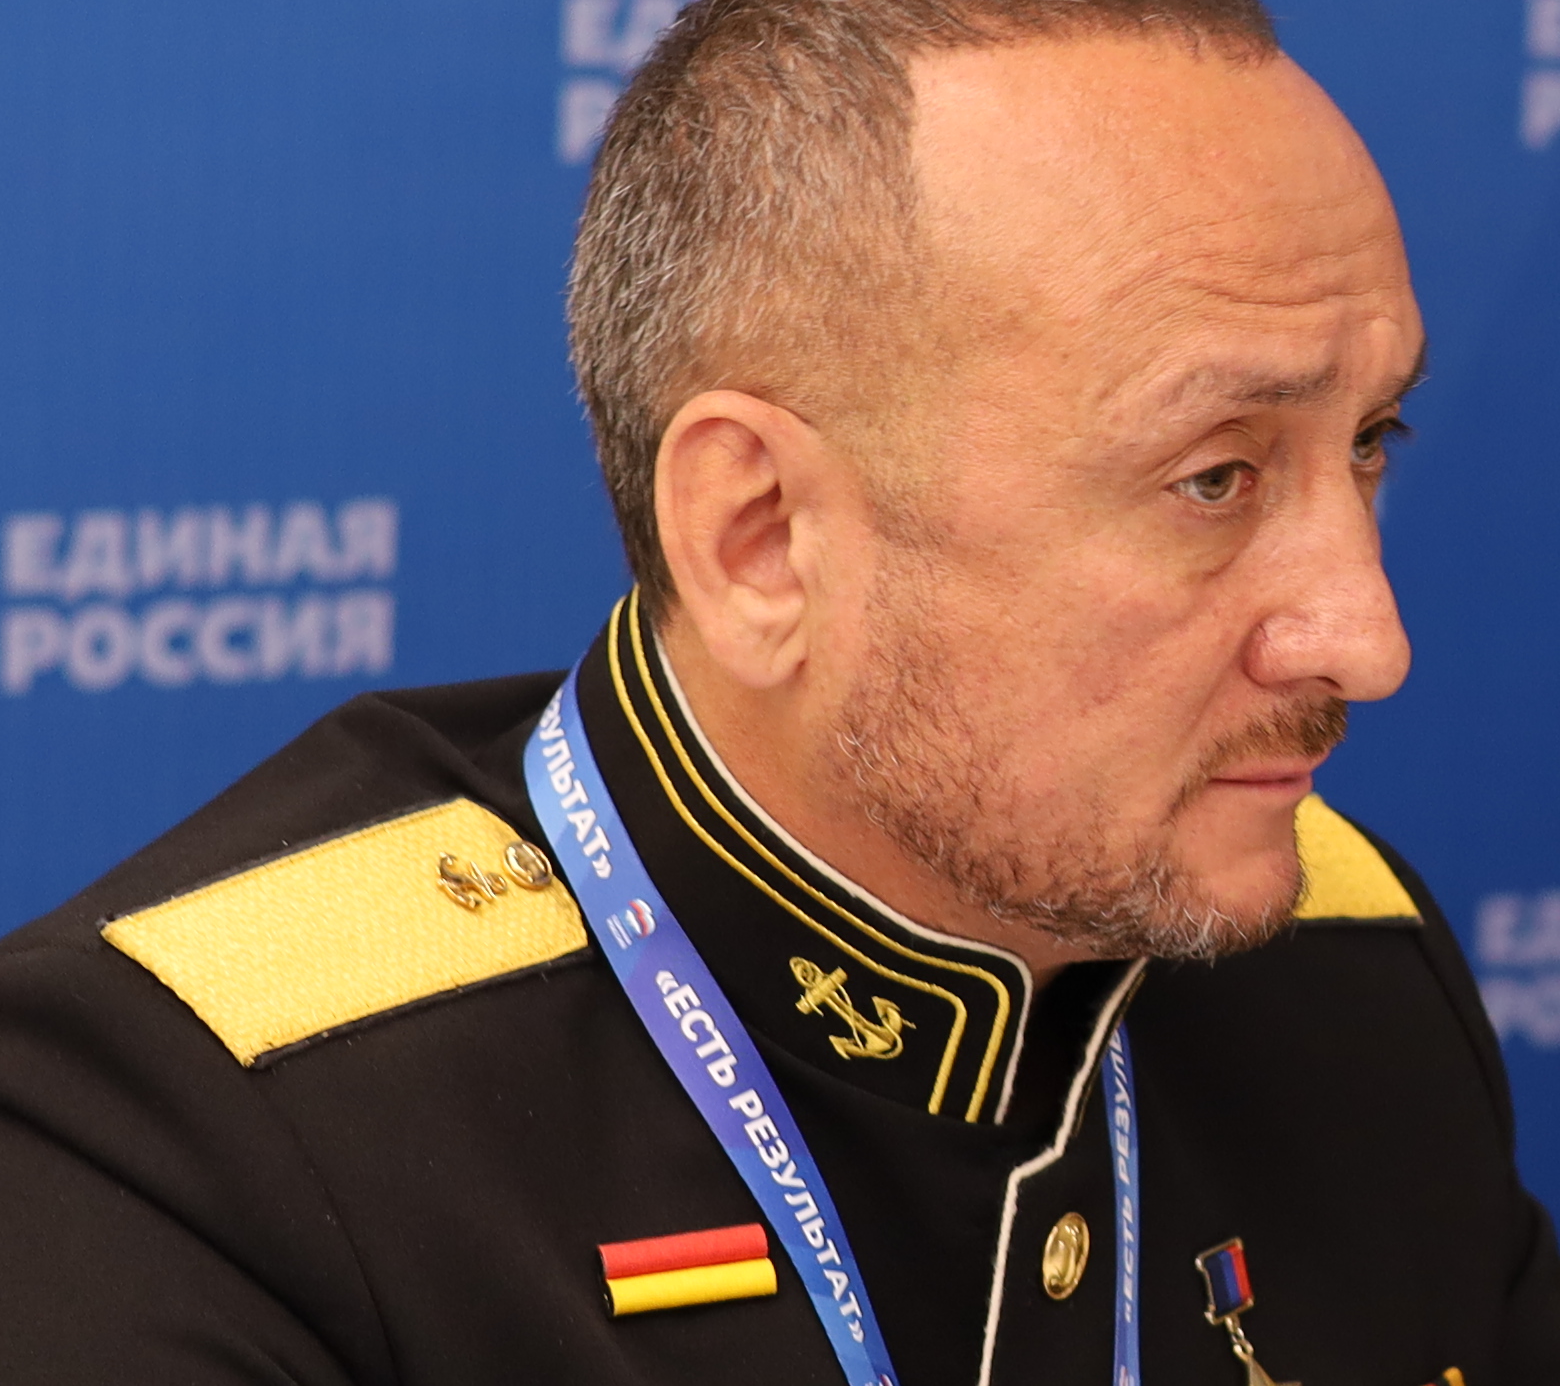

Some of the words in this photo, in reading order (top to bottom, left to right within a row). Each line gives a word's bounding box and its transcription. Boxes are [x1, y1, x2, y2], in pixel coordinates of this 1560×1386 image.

[2, 501, 396, 600] ЕДИНАЯ
[0, 591, 393, 692] РОССИЯ
[655, 969, 738, 1087] «ЕСТЬ
[729, 1089, 866, 1346] РЕЗУЛЬТАТ»
